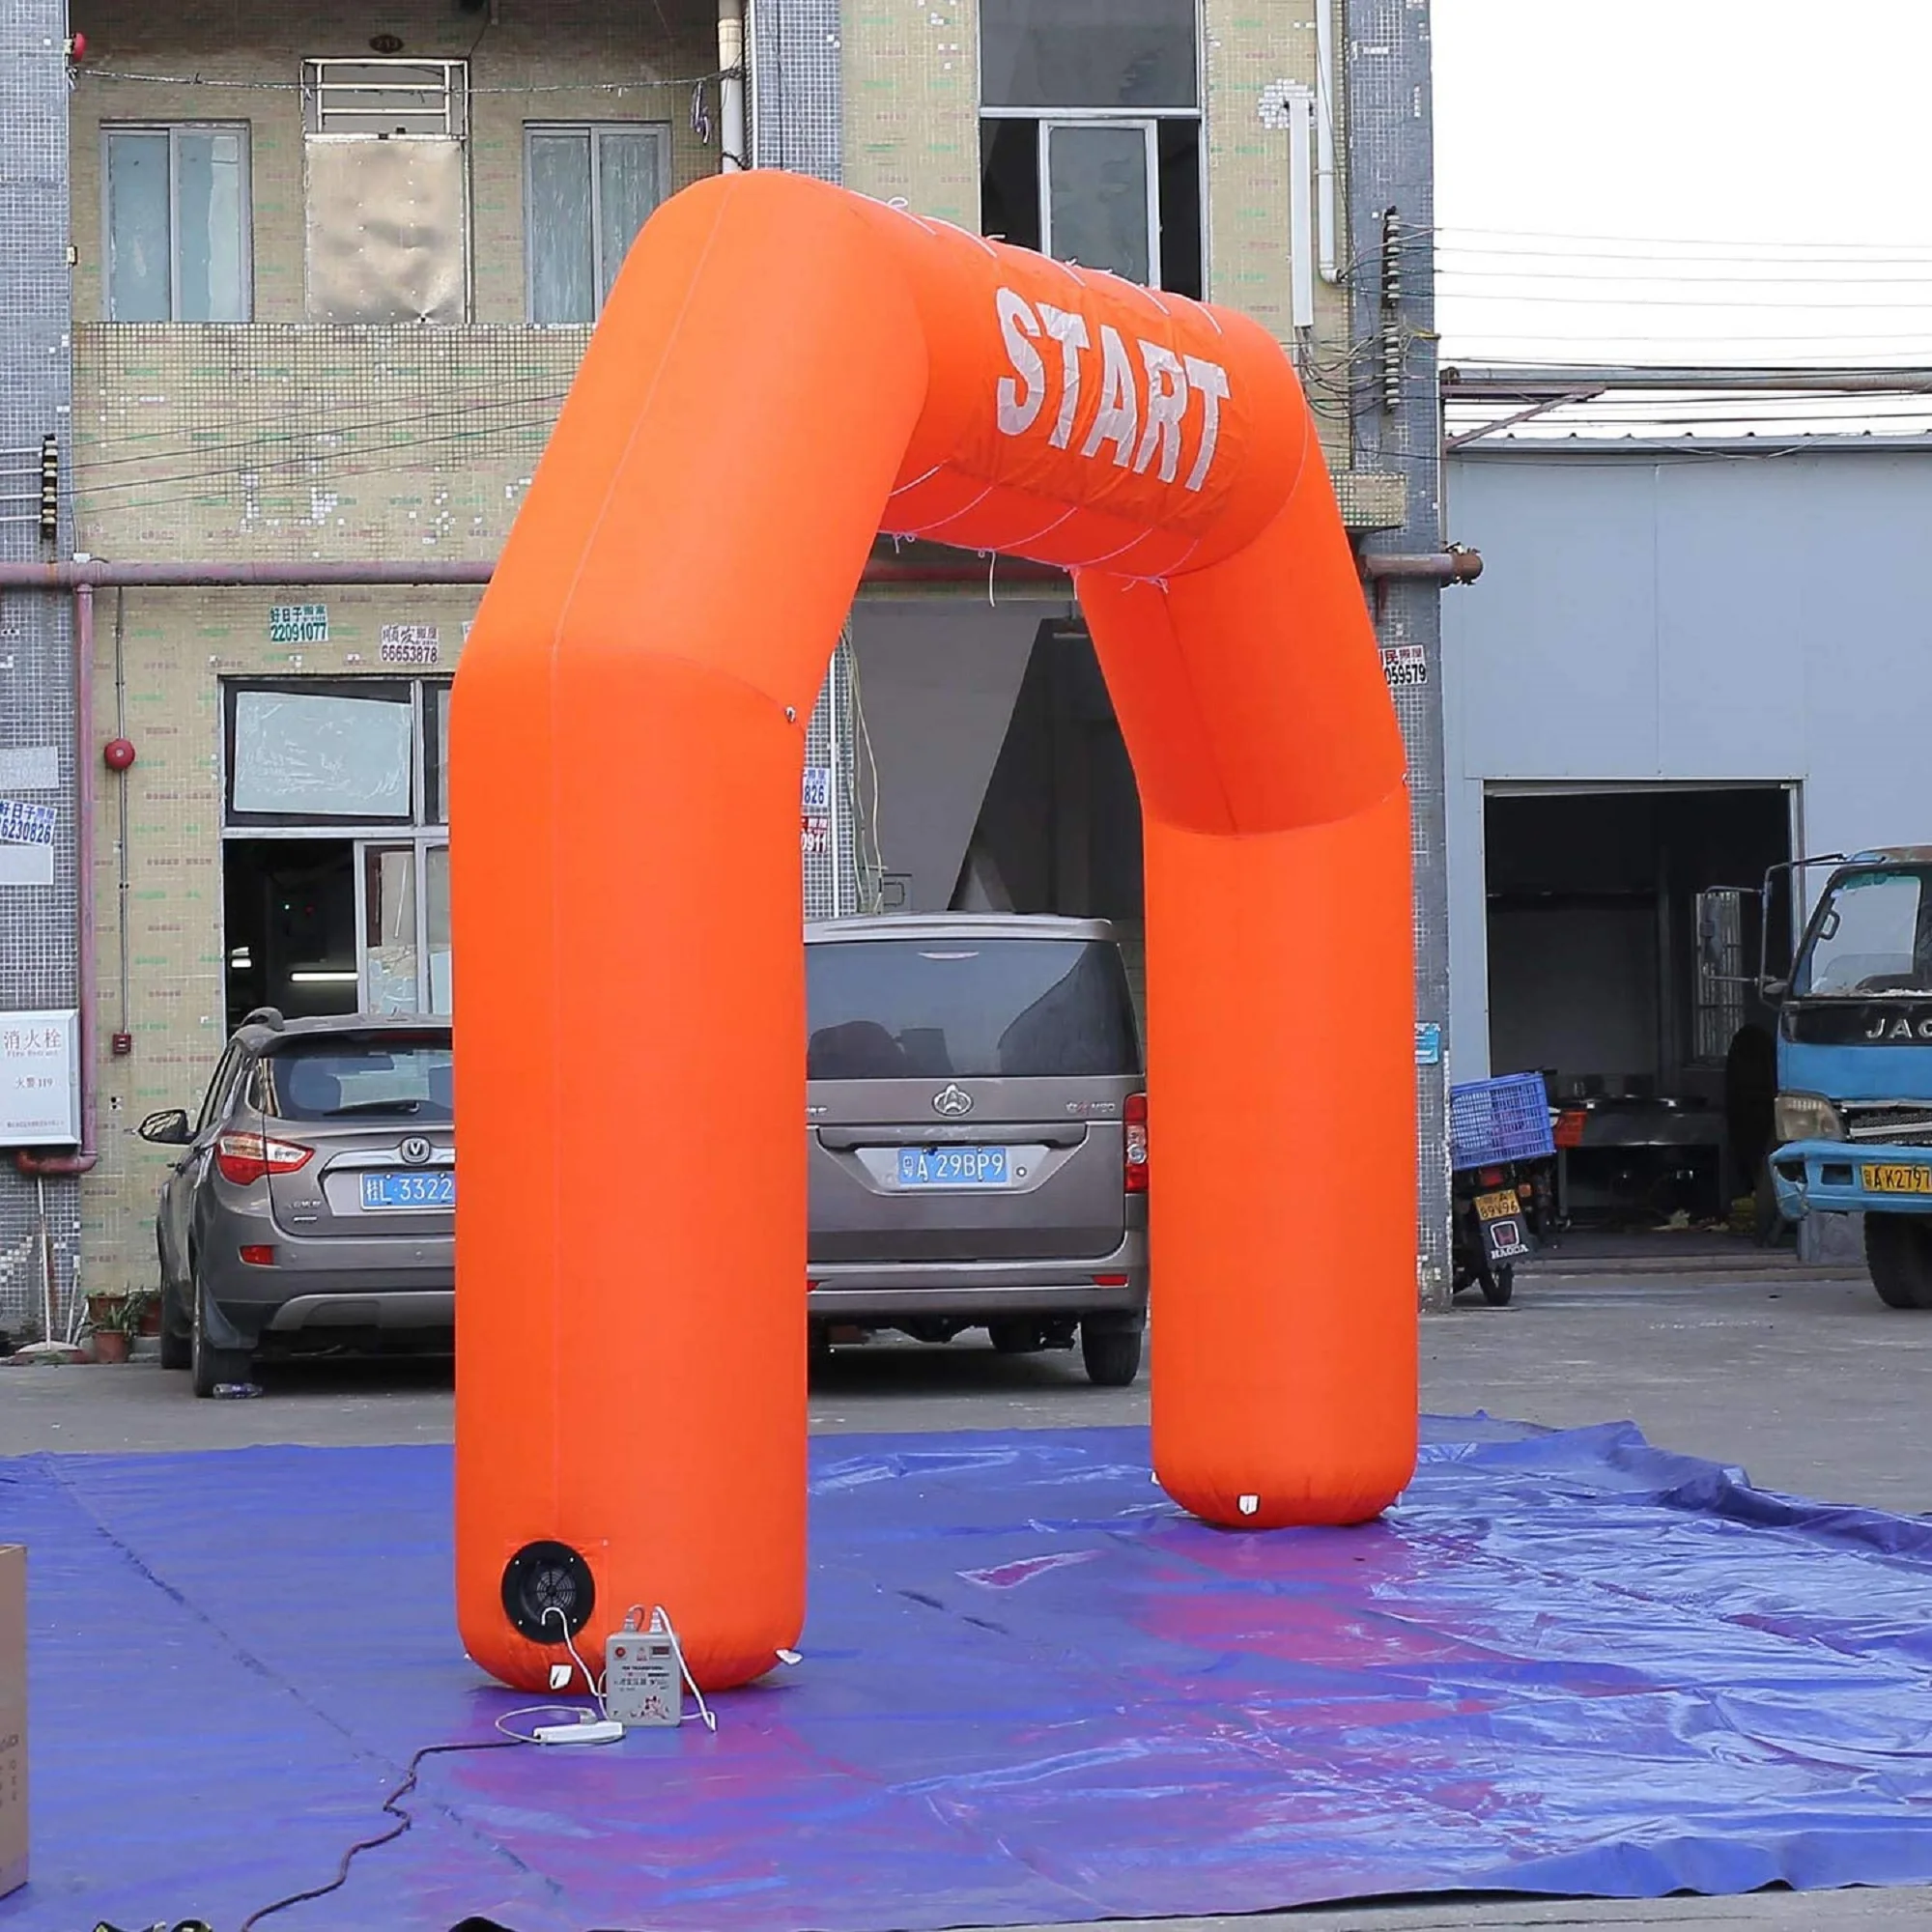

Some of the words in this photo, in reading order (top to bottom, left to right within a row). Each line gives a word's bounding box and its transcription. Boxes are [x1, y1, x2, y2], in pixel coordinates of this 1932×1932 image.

[996, 287, 1231, 493] START
[270, 622, 327, 641] 22091077
[382, 644, 438, 663] 66653878
[805, 784, 824, 804] 826
[0, 818, 51, 843] 6230826
[4, 1029, 62, 1050] 消火栓
